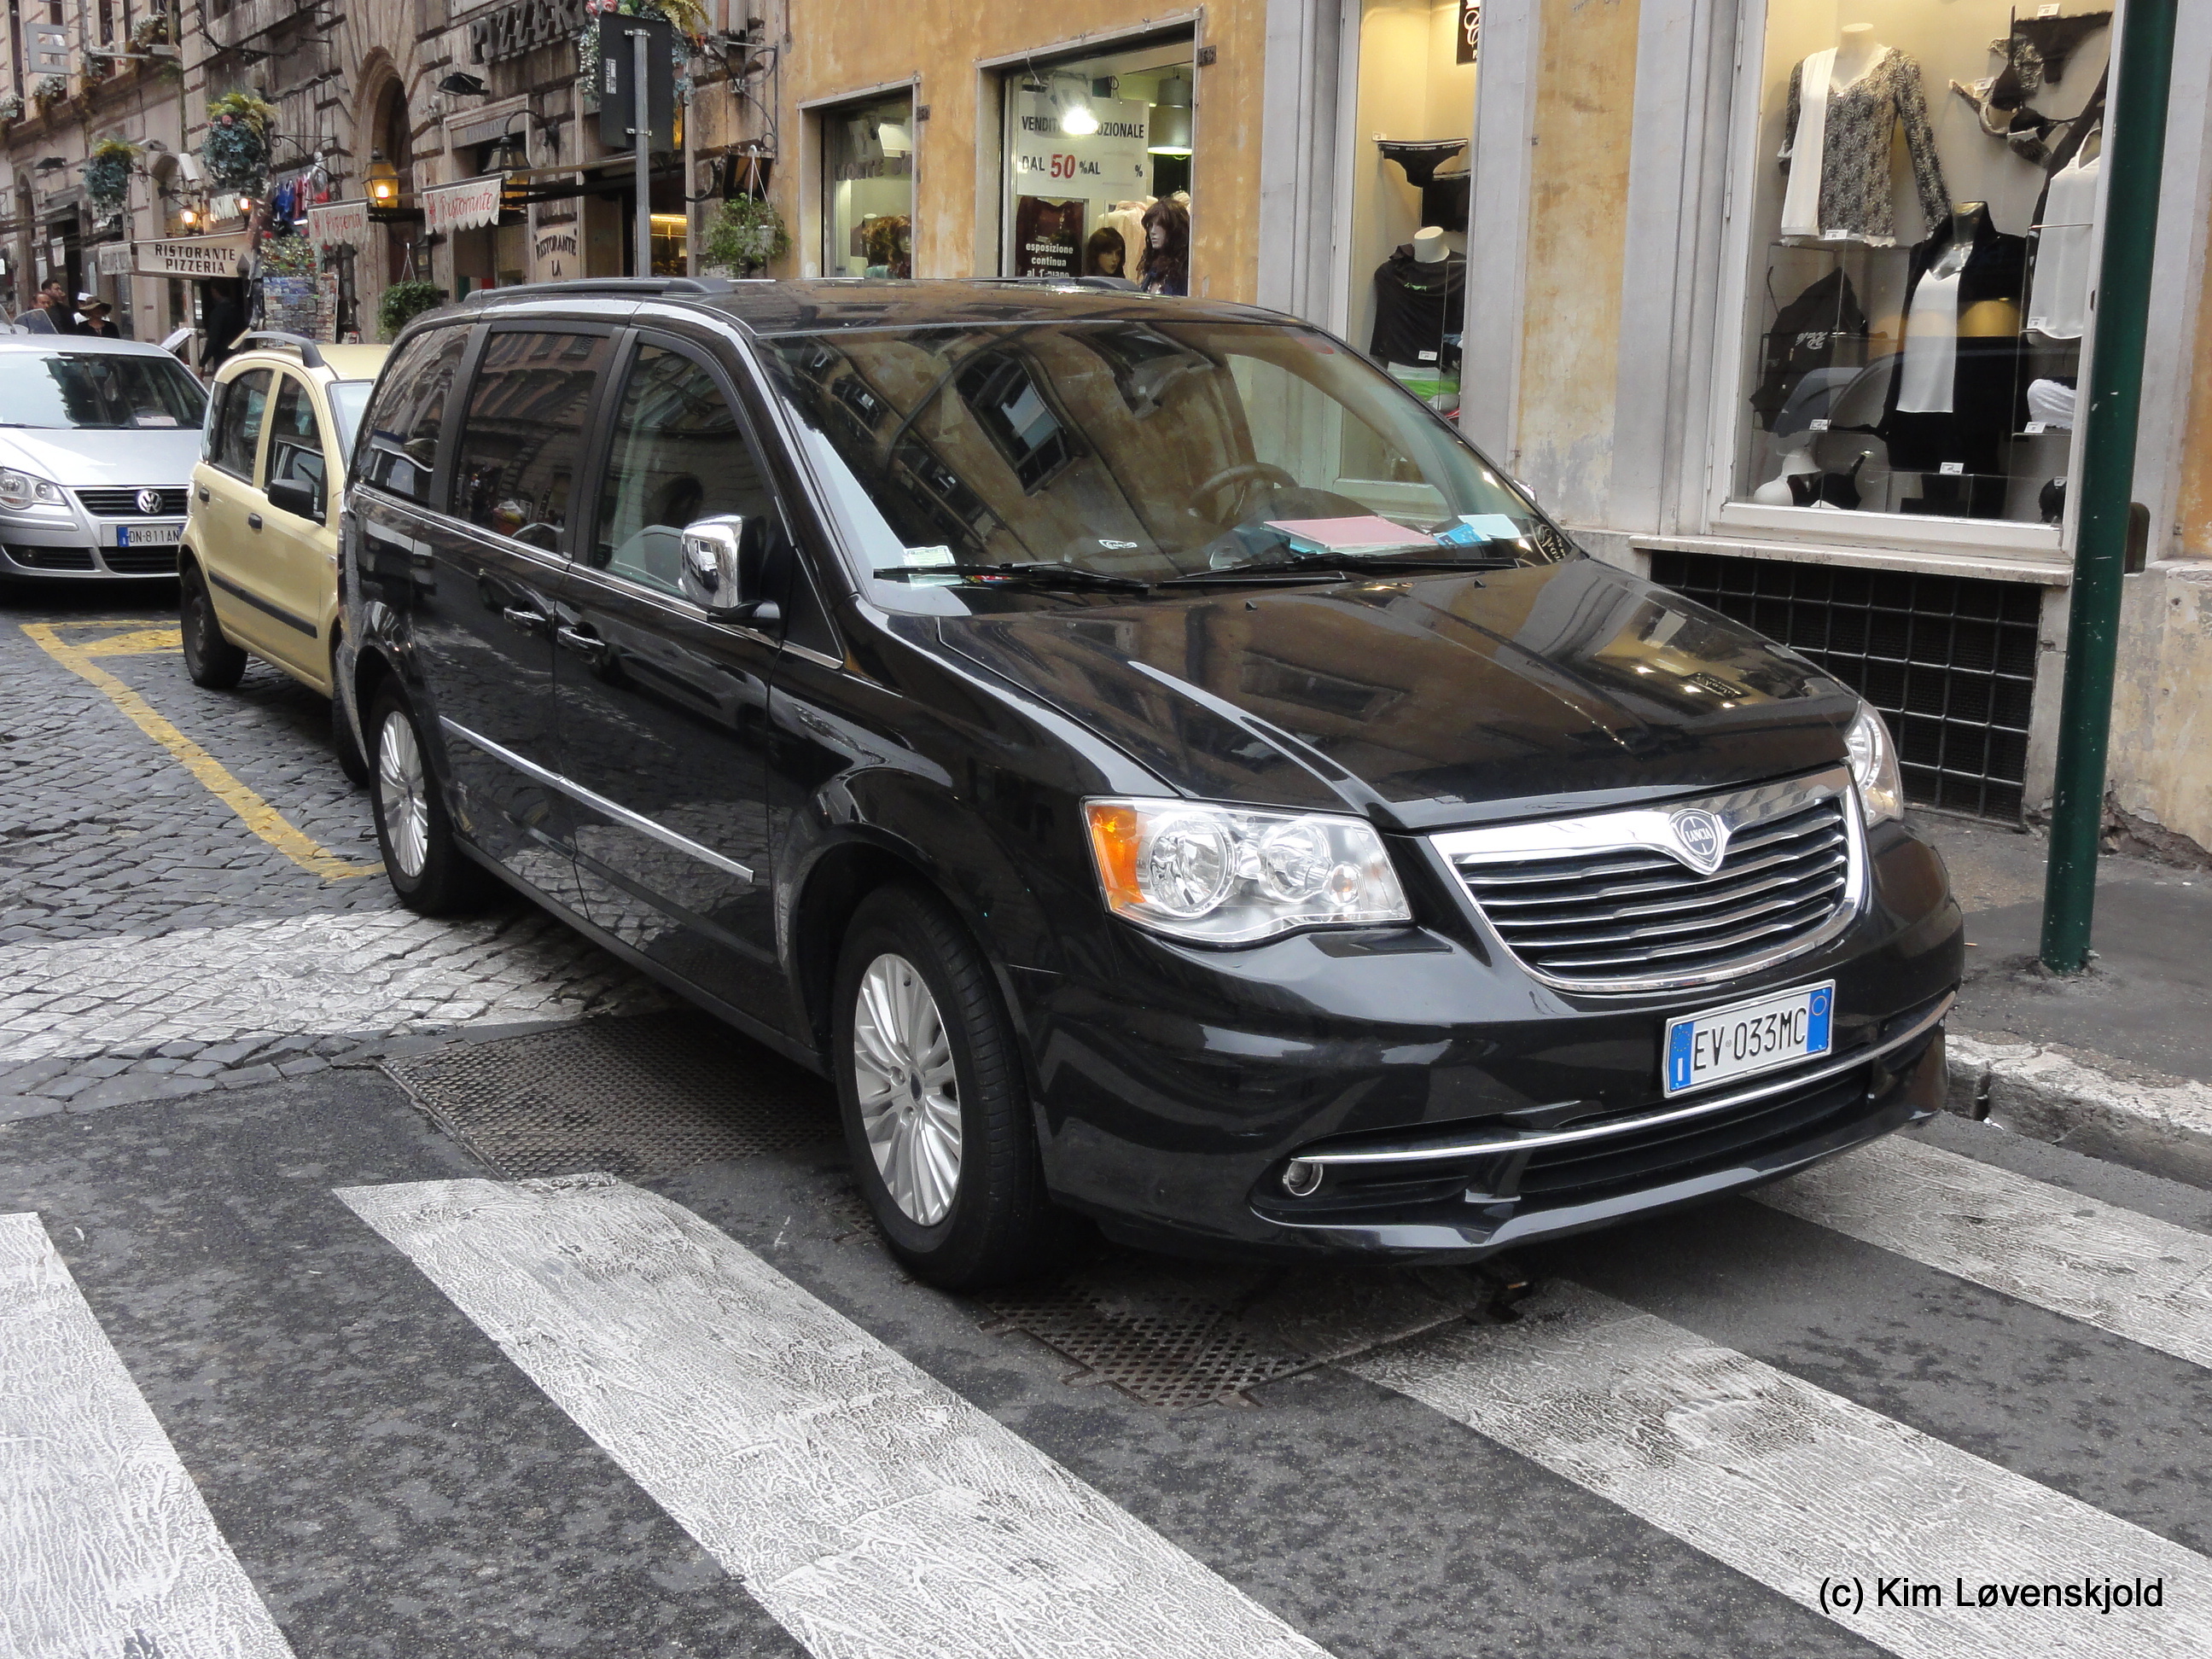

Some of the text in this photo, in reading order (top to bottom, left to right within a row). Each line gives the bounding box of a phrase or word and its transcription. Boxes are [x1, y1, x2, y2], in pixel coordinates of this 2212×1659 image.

[469, 0, 586, 64] PIZZERI
[1022, 116, 1061, 133] VENDIT
[1022, 155, 1045, 172] DAL
[1051, 154, 1076, 178] 50
[439, 189, 493, 220] Ristorante
[154, 243, 236, 261] RISTORANTE
[536, 234, 577, 260] RISTORANTE
[1026, 242, 1074, 254] esposizione
[166, 258, 226, 274] PIZZERIA
[551, 259, 562, 277] LA
[1031, 256, 1067, 267] continua
[1027, 268, 1035, 277] al
[129, 530, 143, 543] DN
[146, 530, 179, 543] 811AN
[1685, 827, 1713, 843] LANCIA
[1694, 1026, 1725, 1071] EV
[1733, 1007, 1807, 1060] 033MC
